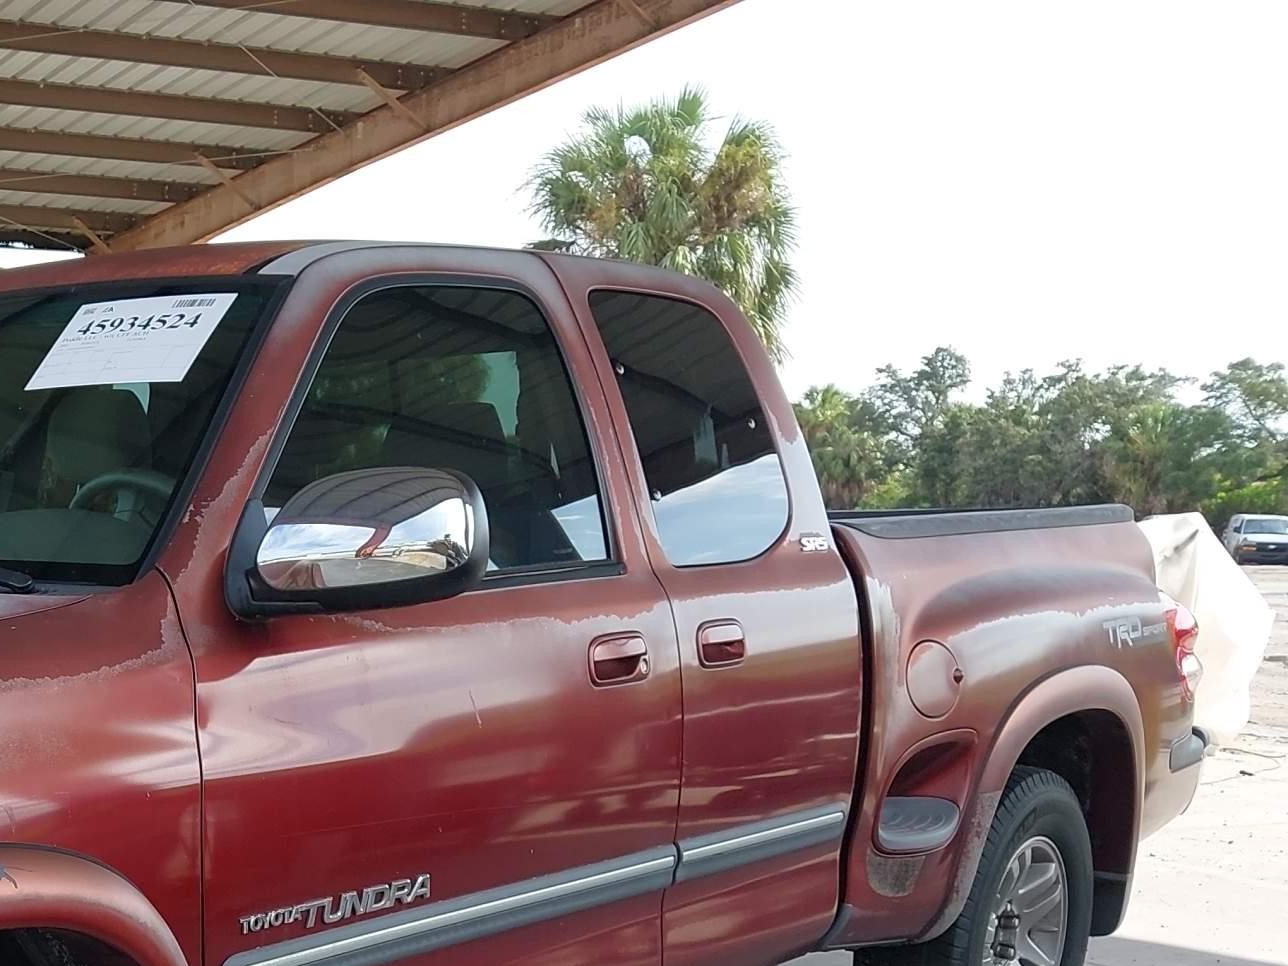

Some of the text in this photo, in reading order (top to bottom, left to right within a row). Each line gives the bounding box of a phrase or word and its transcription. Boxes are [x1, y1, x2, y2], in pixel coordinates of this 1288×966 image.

[77, 312, 203, 336] 45934524
[1103, 617, 1142, 649] TRD
[239, 873, 431, 935] TOYOTA TUNDRA
